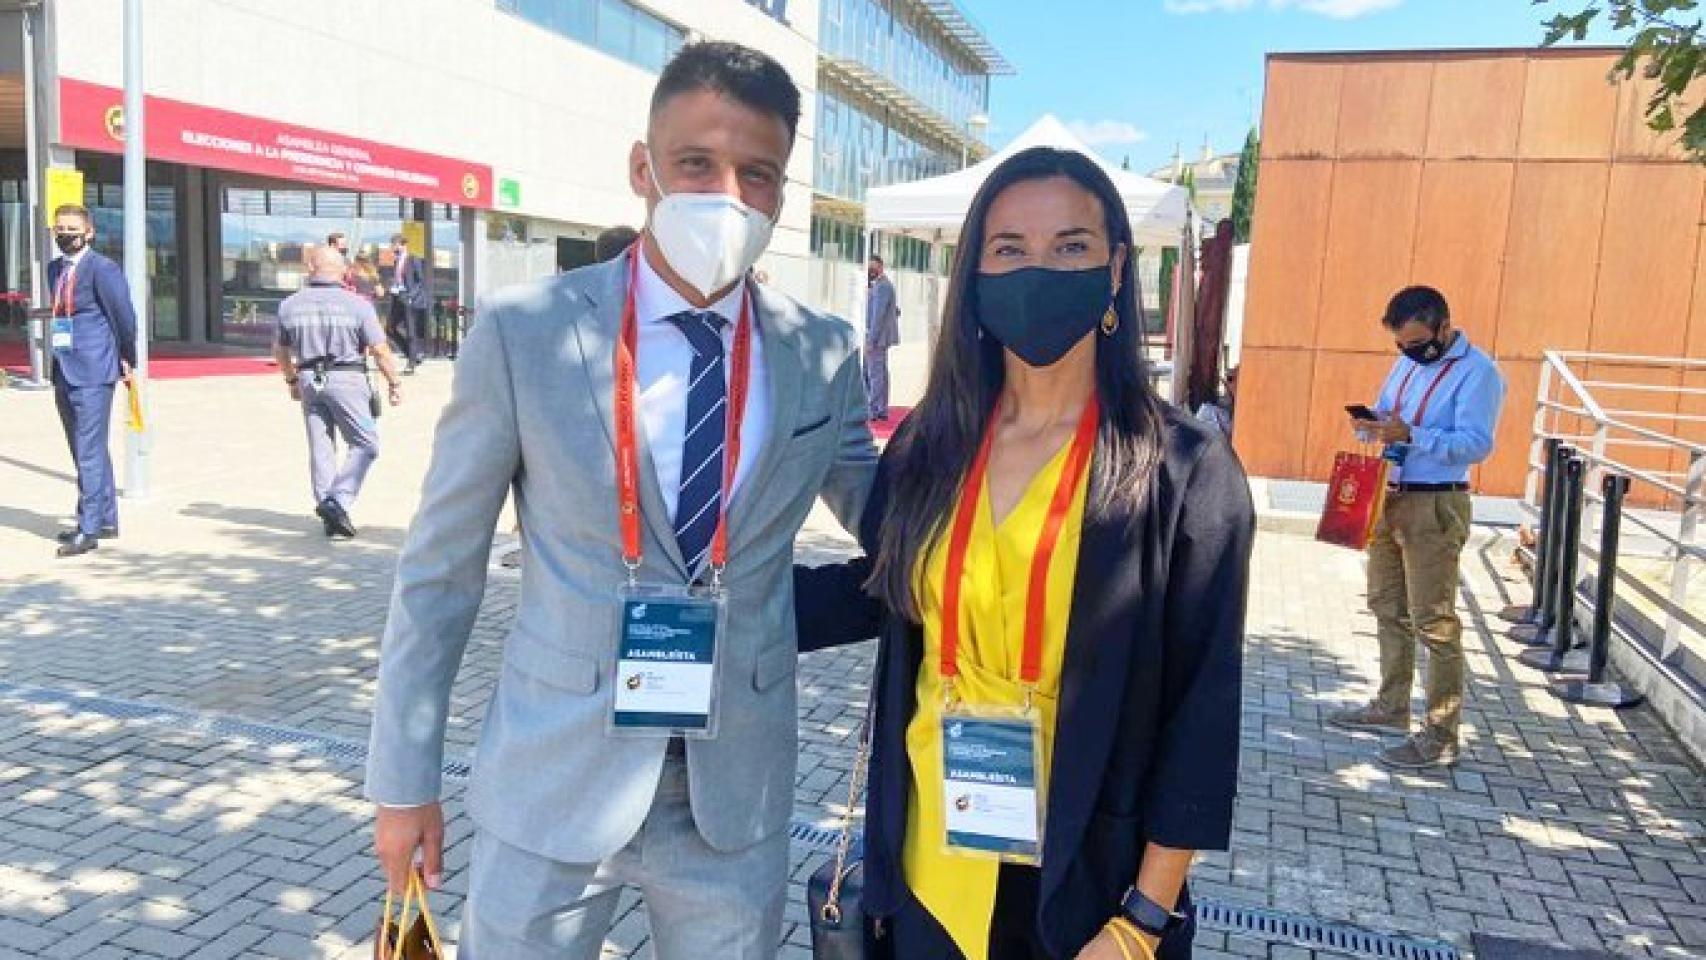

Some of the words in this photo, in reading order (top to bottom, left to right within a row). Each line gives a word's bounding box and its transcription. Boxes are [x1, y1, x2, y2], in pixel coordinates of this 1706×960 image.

[182, 130, 252, 154] ELECCIONES
[255, 142, 264, 157] A
[265, 146, 280, 159] LA
